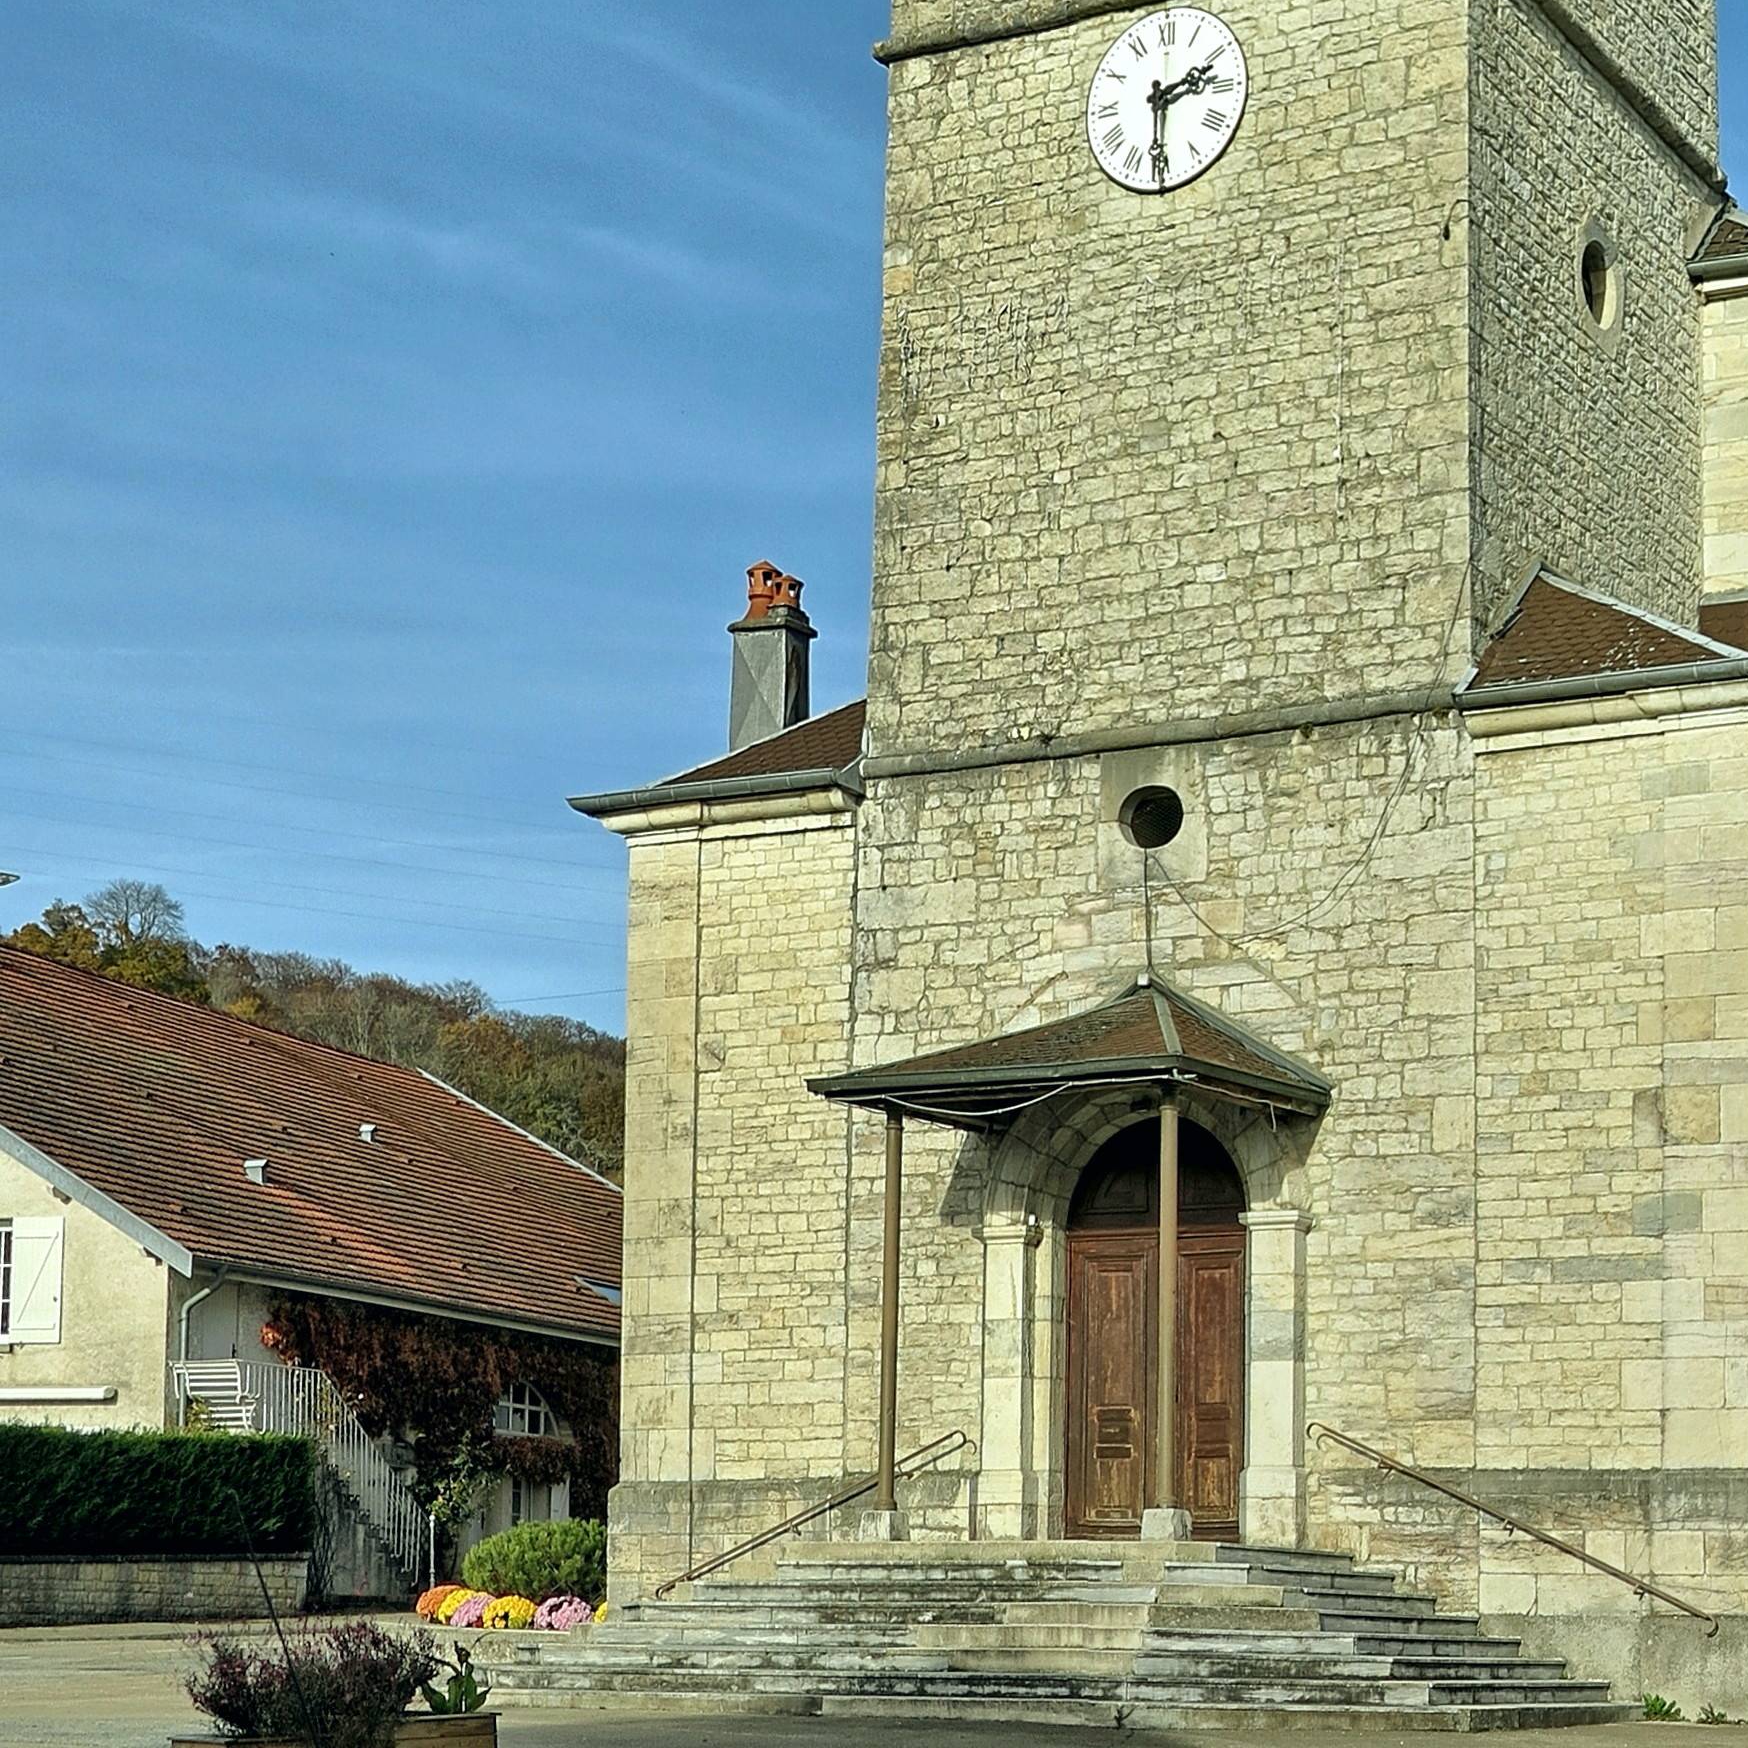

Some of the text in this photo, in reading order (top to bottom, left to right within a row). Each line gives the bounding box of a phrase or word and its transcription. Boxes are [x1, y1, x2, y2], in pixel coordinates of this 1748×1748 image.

[1158, 21, 1176, 48] XII
[1128, 36, 1148, 62] XI
[1204, 45, 1226, 64] II
[1106, 69, 1127, 84] X
[1211, 78, 1234, 94] III
[1098, 101, 1119, 119] IX
[1102, 123, 1126, 156] VIII
[1123, 145, 1143, 174] VII
[1187, 140, 1200, 160] V
